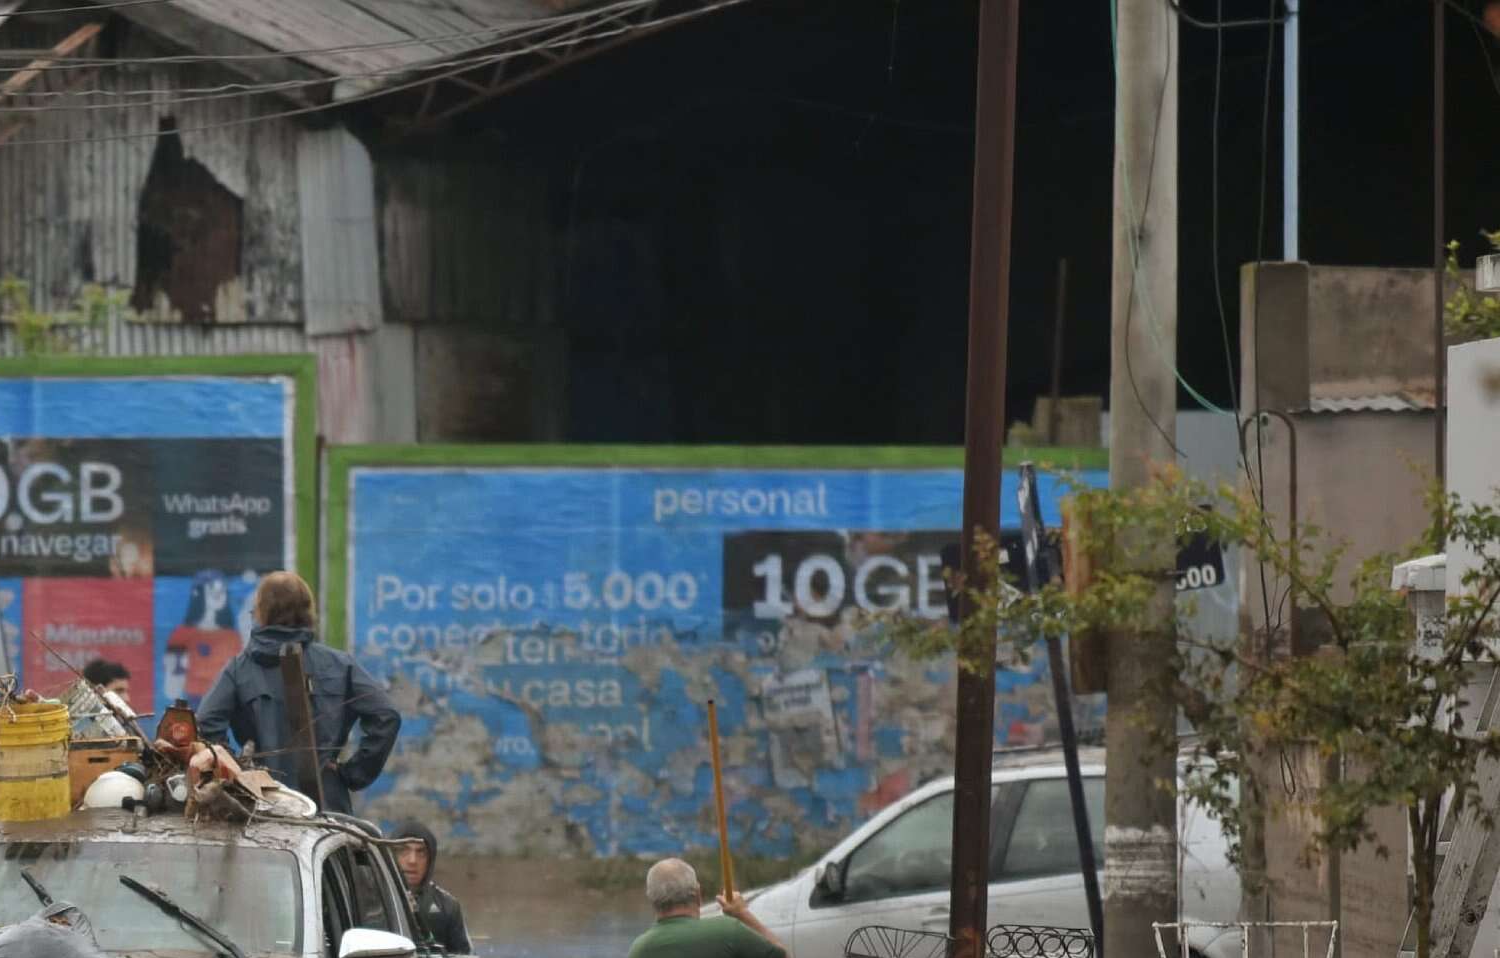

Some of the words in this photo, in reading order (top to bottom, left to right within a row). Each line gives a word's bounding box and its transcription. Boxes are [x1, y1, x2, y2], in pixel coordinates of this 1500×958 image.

[163, 493, 271, 518] WhatsApp
[654, 482, 828, 522] personal
[189, 515, 247, 538] gratis
[1, 533, 123, 562] navegar
[451, 575, 535, 611] solo
[522, 678, 624, 708] casa
